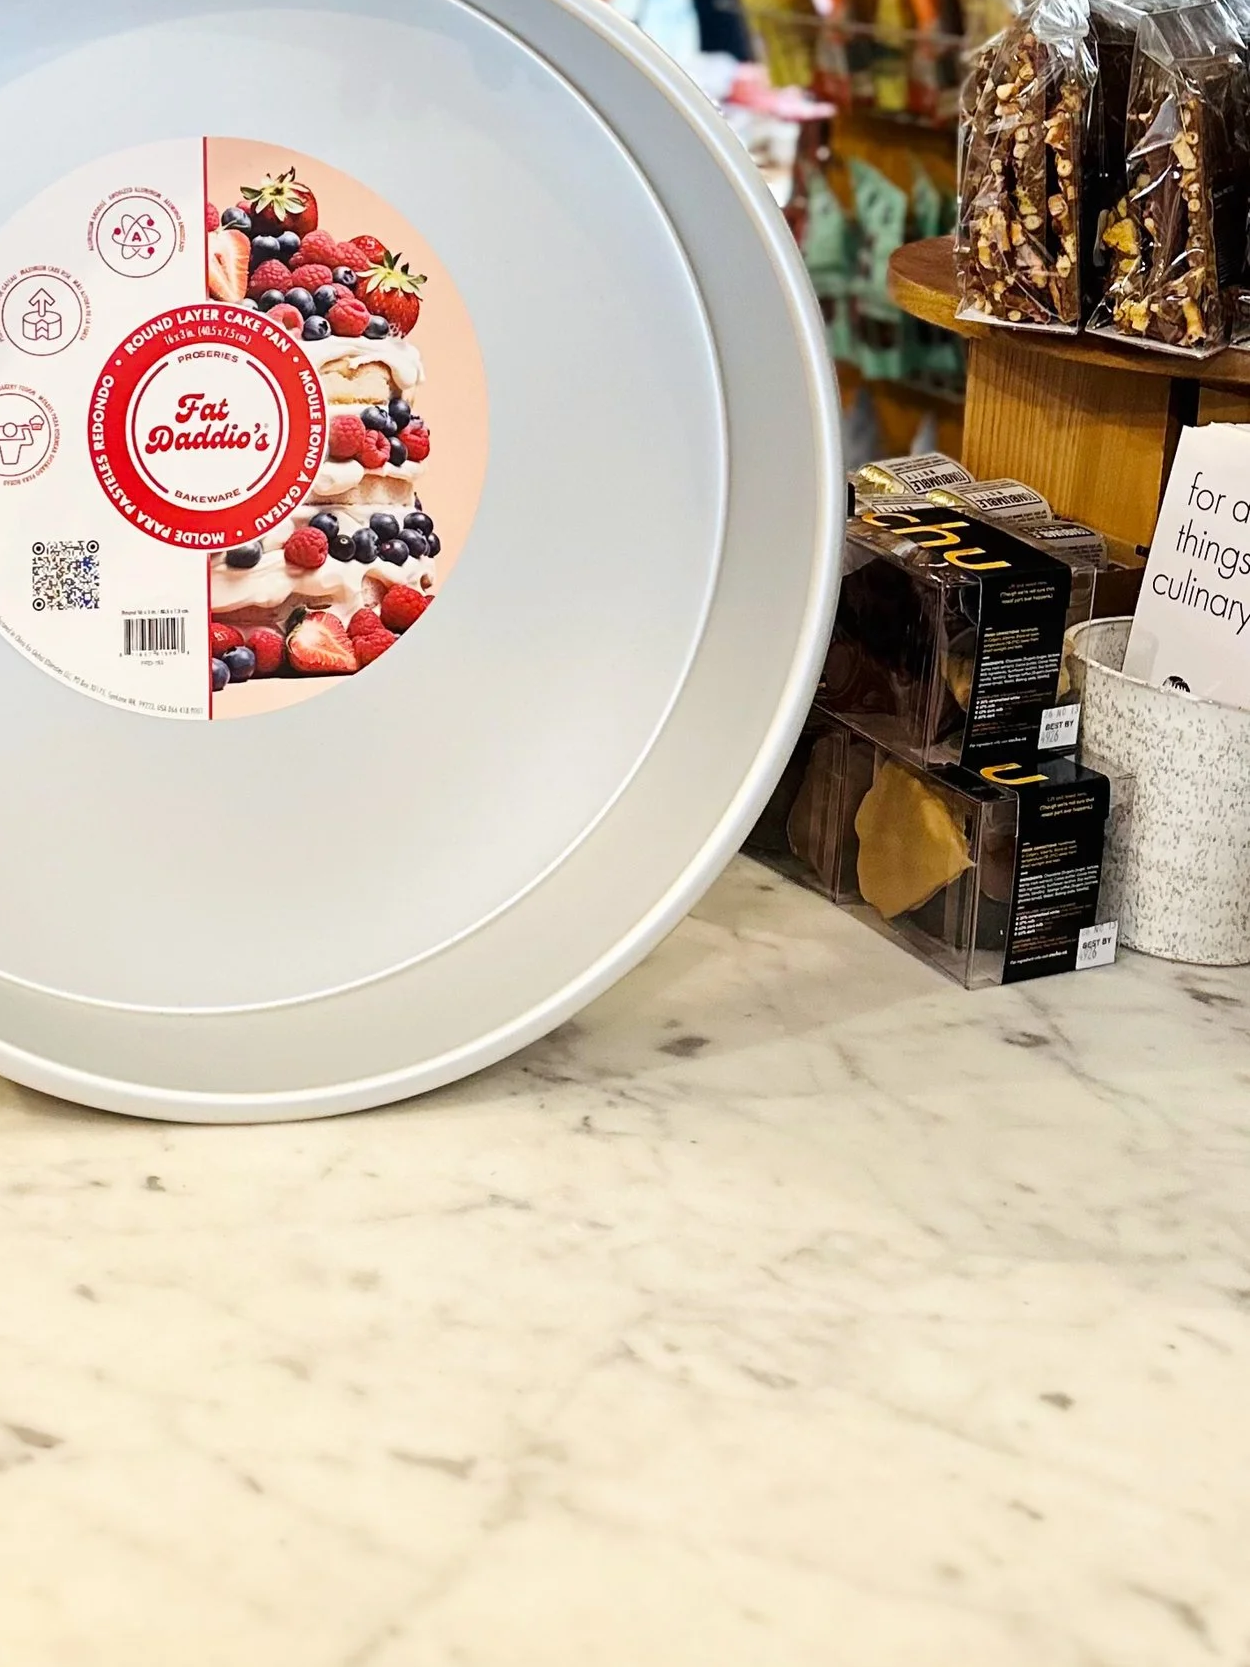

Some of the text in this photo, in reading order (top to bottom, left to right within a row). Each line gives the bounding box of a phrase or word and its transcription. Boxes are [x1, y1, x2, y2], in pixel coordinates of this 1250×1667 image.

[124, 308, 292, 356] ROUND LAYER CAKE PAN
[164, 334, 174, 345] 16
[178, 350, 239, 364] PROSERIES
[174, 392, 230, 424] Fat
[298, 370, 322, 420] MOULE
[144, 422, 270, 455] Daddio's
[304, 424, 322, 470] ROND
[92, 374, 225, 546] MOLDE PARA PASTELES REDONDO
[174, 488, 242, 504] BAKEWARE
[912, 470, 966, 494] TOMBUMBLE
[978, 491, 1039, 510] TOMBUMBLE
[1188, 471, 1226, 515] for
[254, 488, 301, 531] GÂTEAU
[1176, 518, 1250, 580] things
[1152, 568, 1250, 635] culinary
[1045, 721, 1062, 731] BEST
[1064, 720, 1074, 728] BY
